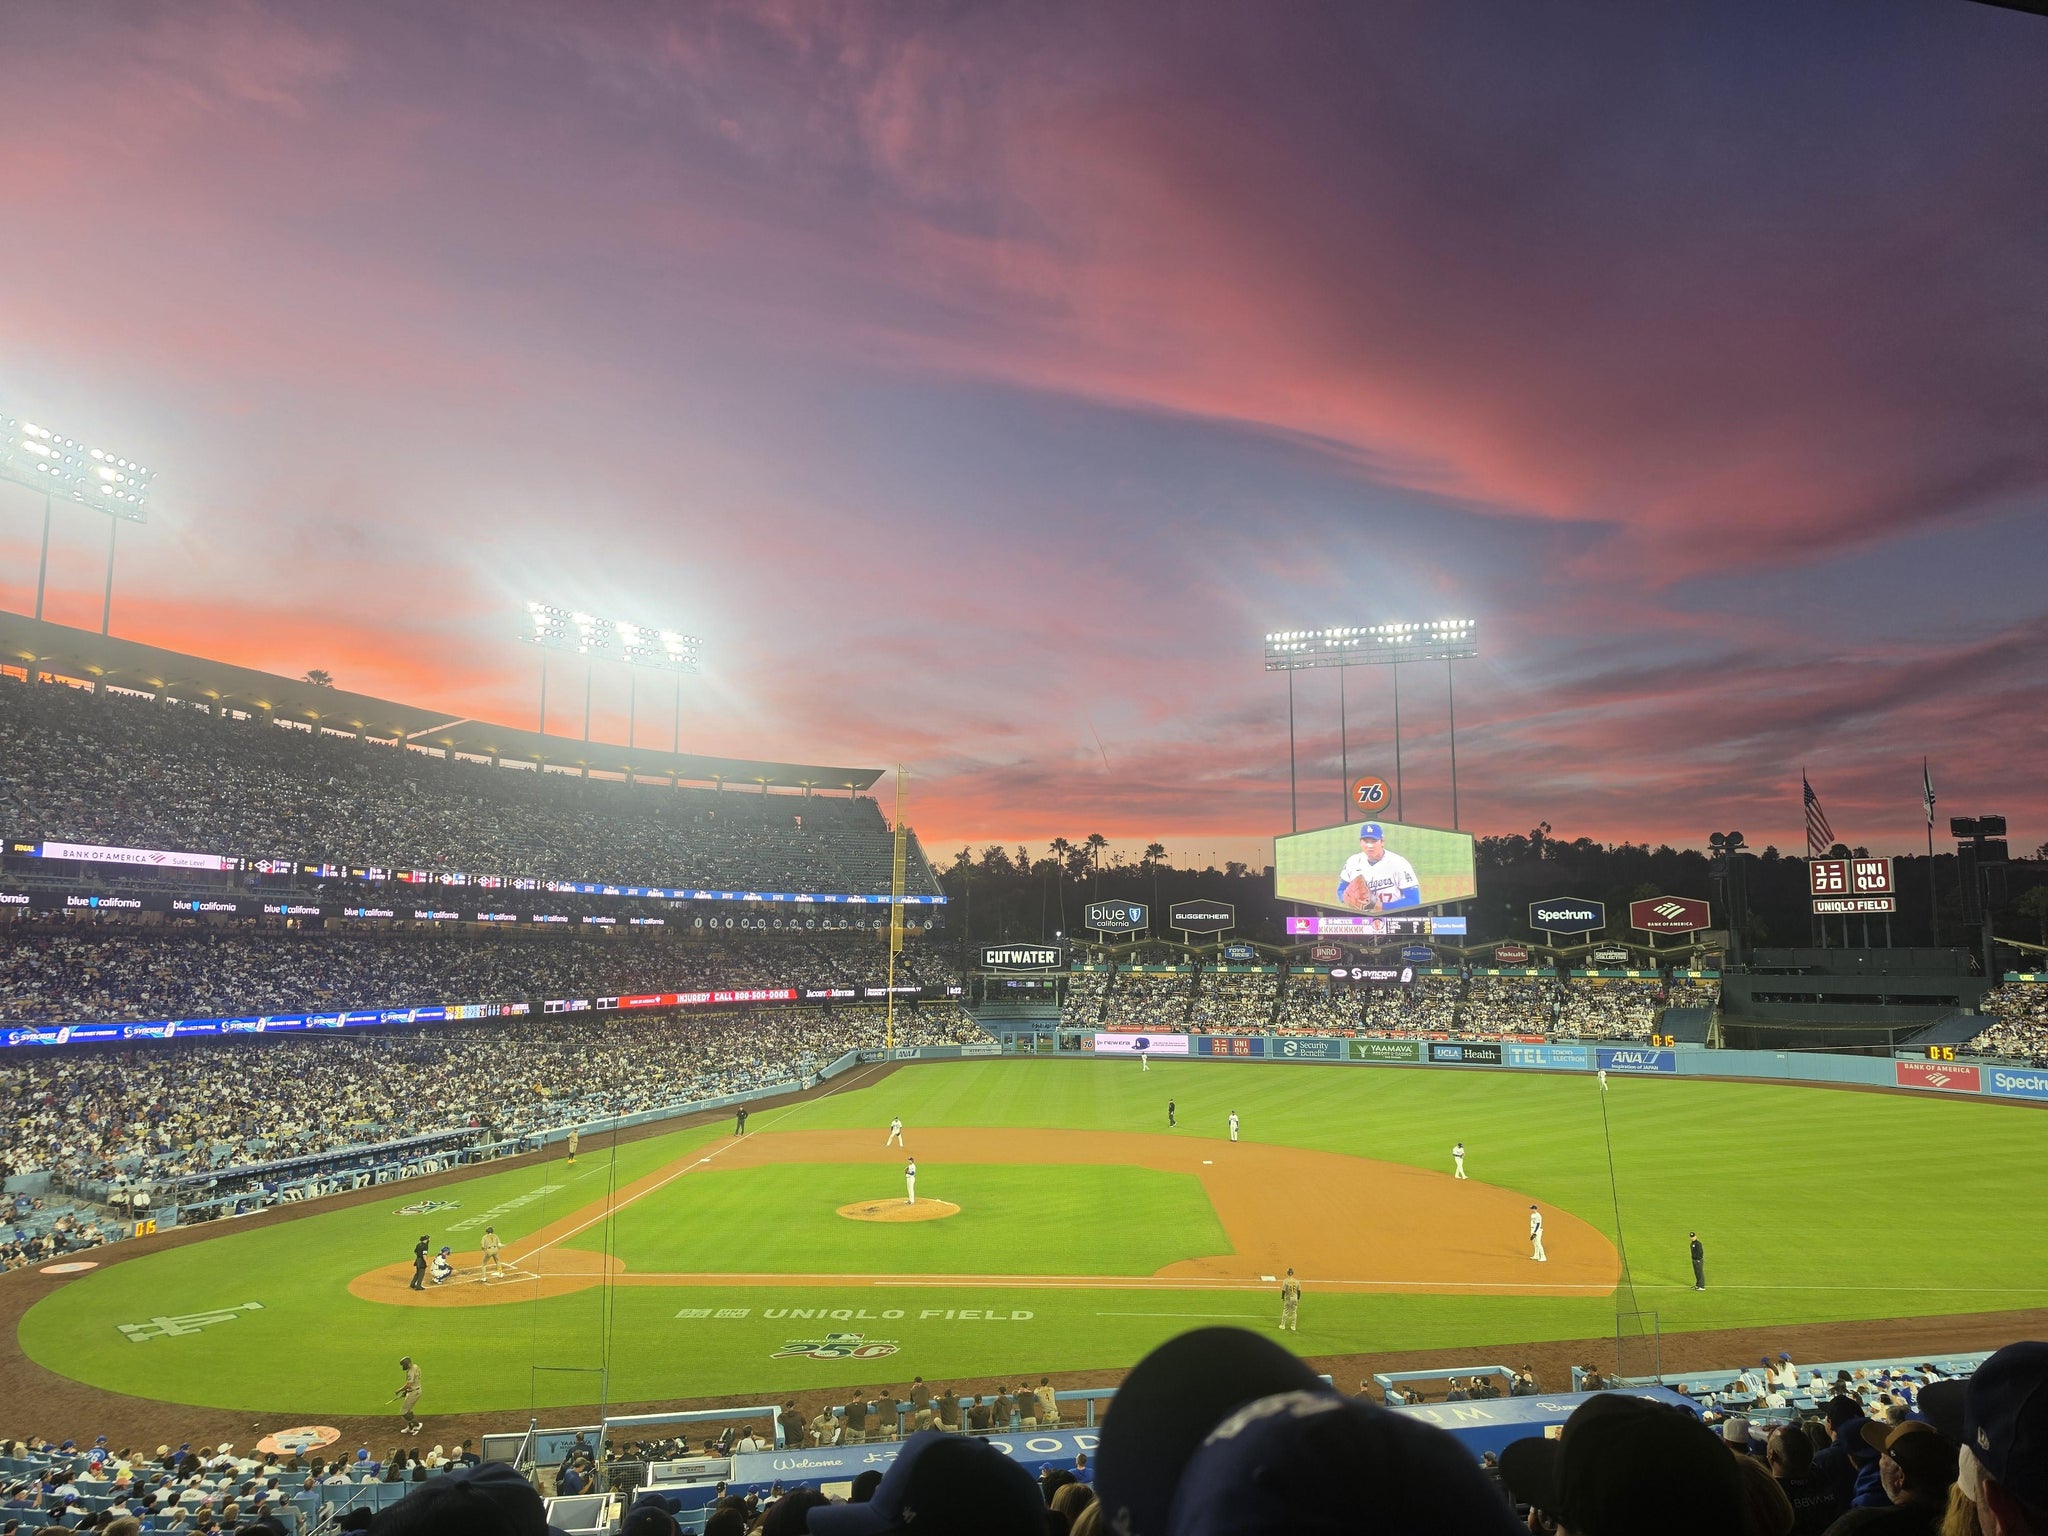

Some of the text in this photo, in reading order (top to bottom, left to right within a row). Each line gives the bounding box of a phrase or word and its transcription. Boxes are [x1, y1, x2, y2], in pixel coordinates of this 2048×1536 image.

[1357, 783, 1382, 803] 76
[14, 844, 35, 852] FINAL
[63, 850, 146, 863] BANK OF AMERICA
[172, 858, 206, 867] Suite Level
[1856, 863, 1883, 876] UNI
[1366, 877, 1393, 895] dgers
[1857, 876, 1886, 890] QLO
[67, 896, 141, 908] blue california
[173, 900, 236, 912] blue california
[1817, 900, 1888, 912] UNIQLO FIELD
[264, 904, 320, 915] blue california
[344, 907, 394, 917] blue california
[415, 910, 458, 919] blue california
[1091, 906, 1125, 921] blue
[1537, 909, 1592, 922] Spectrum
[477, 912, 489, 920] blue
[986, 951, 1055, 963] CUTWATER
[1316, 948, 1337, 957] JINRO
[677, 990, 789, 1003] INJURED? CALL 800-500-0000
[1083, 1040, 1093, 1048] 76
[1299, 1041, 1329, 1051] Security
[1652, 1034, 1675, 1047] 0:15
[1437, 1049, 1495, 1059] UCLA Health
[1511, 1048, 1546, 1064] TEL
[1553, 1055, 1585, 1063] ELECTRON
[1611, 1051, 1642, 1063] ANA
[1930, 1046, 1954, 1061] 0:15
[1904, 1063, 1924, 1071] BANK
[1936, 1065, 1971, 1074] AMERICA
[763, 1309, 1035, 1322] UNIQLO FIELD
[773, 1457, 844, 1471] Welcome
